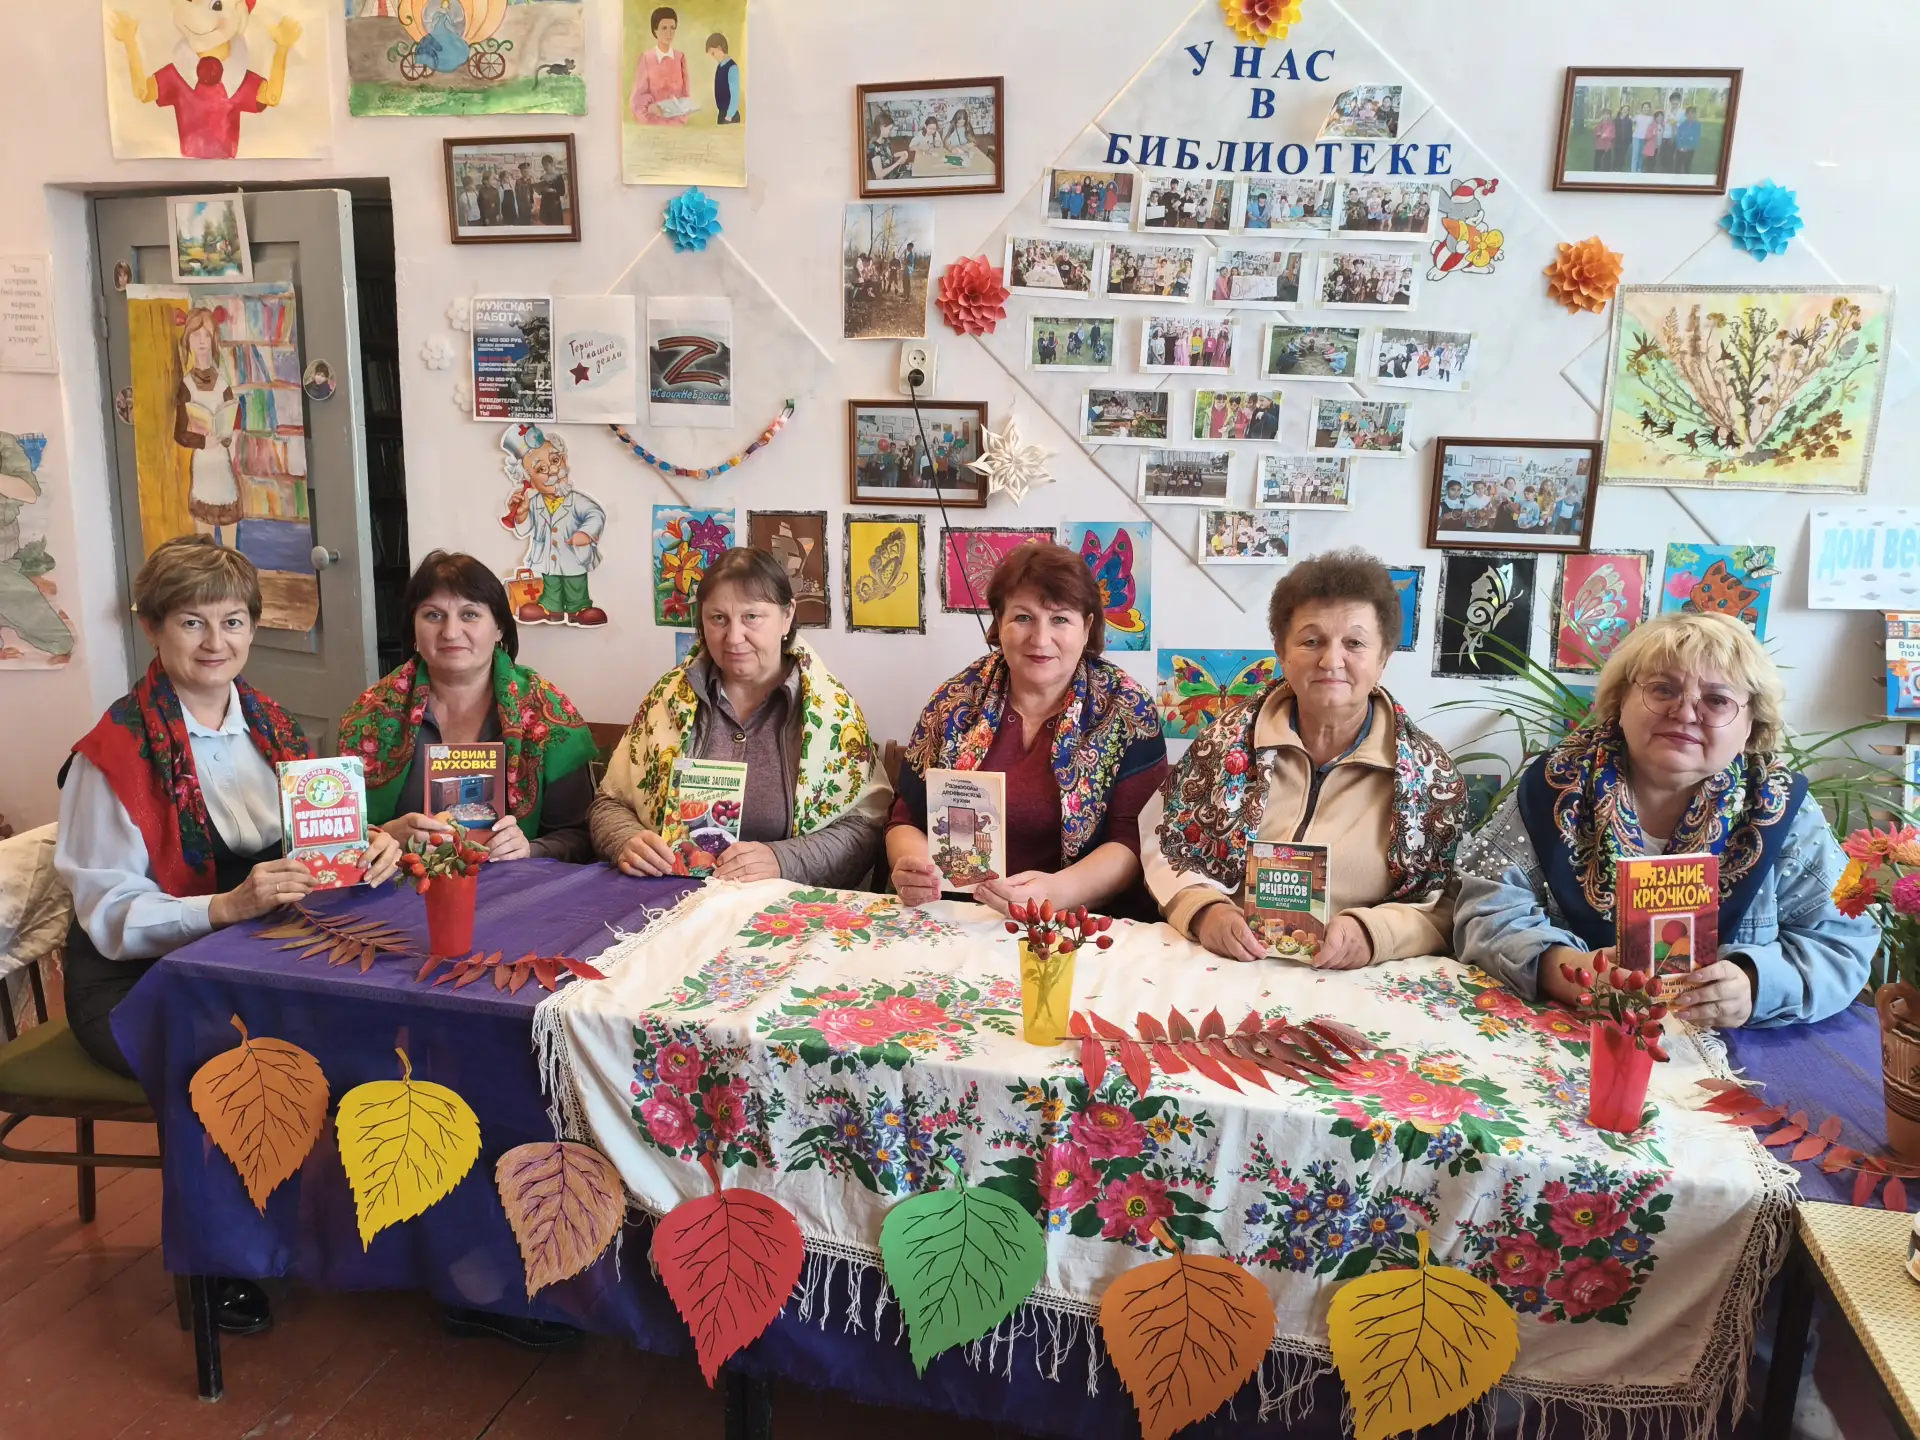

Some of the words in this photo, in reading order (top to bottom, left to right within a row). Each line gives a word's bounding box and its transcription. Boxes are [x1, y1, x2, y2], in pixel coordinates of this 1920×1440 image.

[1184, 41, 1214, 76] У
[1230, 46, 1336, 82] НАС
[1247, 87, 1276, 119] В
[1102, 132, 1453, 176] БИБЛИОТЕКЕ
[476, 301, 533, 311] МУЖСКАЯ
[476, 312, 522, 322] РАБОТА
[534, 380, 552, 389] 122
[431, 750, 486, 760] ТОВИМ
[489, 750, 497, 759] В
[431, 760, 497, 771] ДУХОВКЕ
[329, 769, 350, 788] КНИГА
[681, 774, 711, 785] ДОМАШНИЕ
[711, 776, 740, 787] ЗАГОТОВКИ
[299, 816, 354, 839] БЛЮДА
[1268, 871, 1299, 884] 1000
[1259, 883, 1308, 897] РЕЦЕПТОВ
[1633, 885, 1711, 909] КРЮЧКОМ
